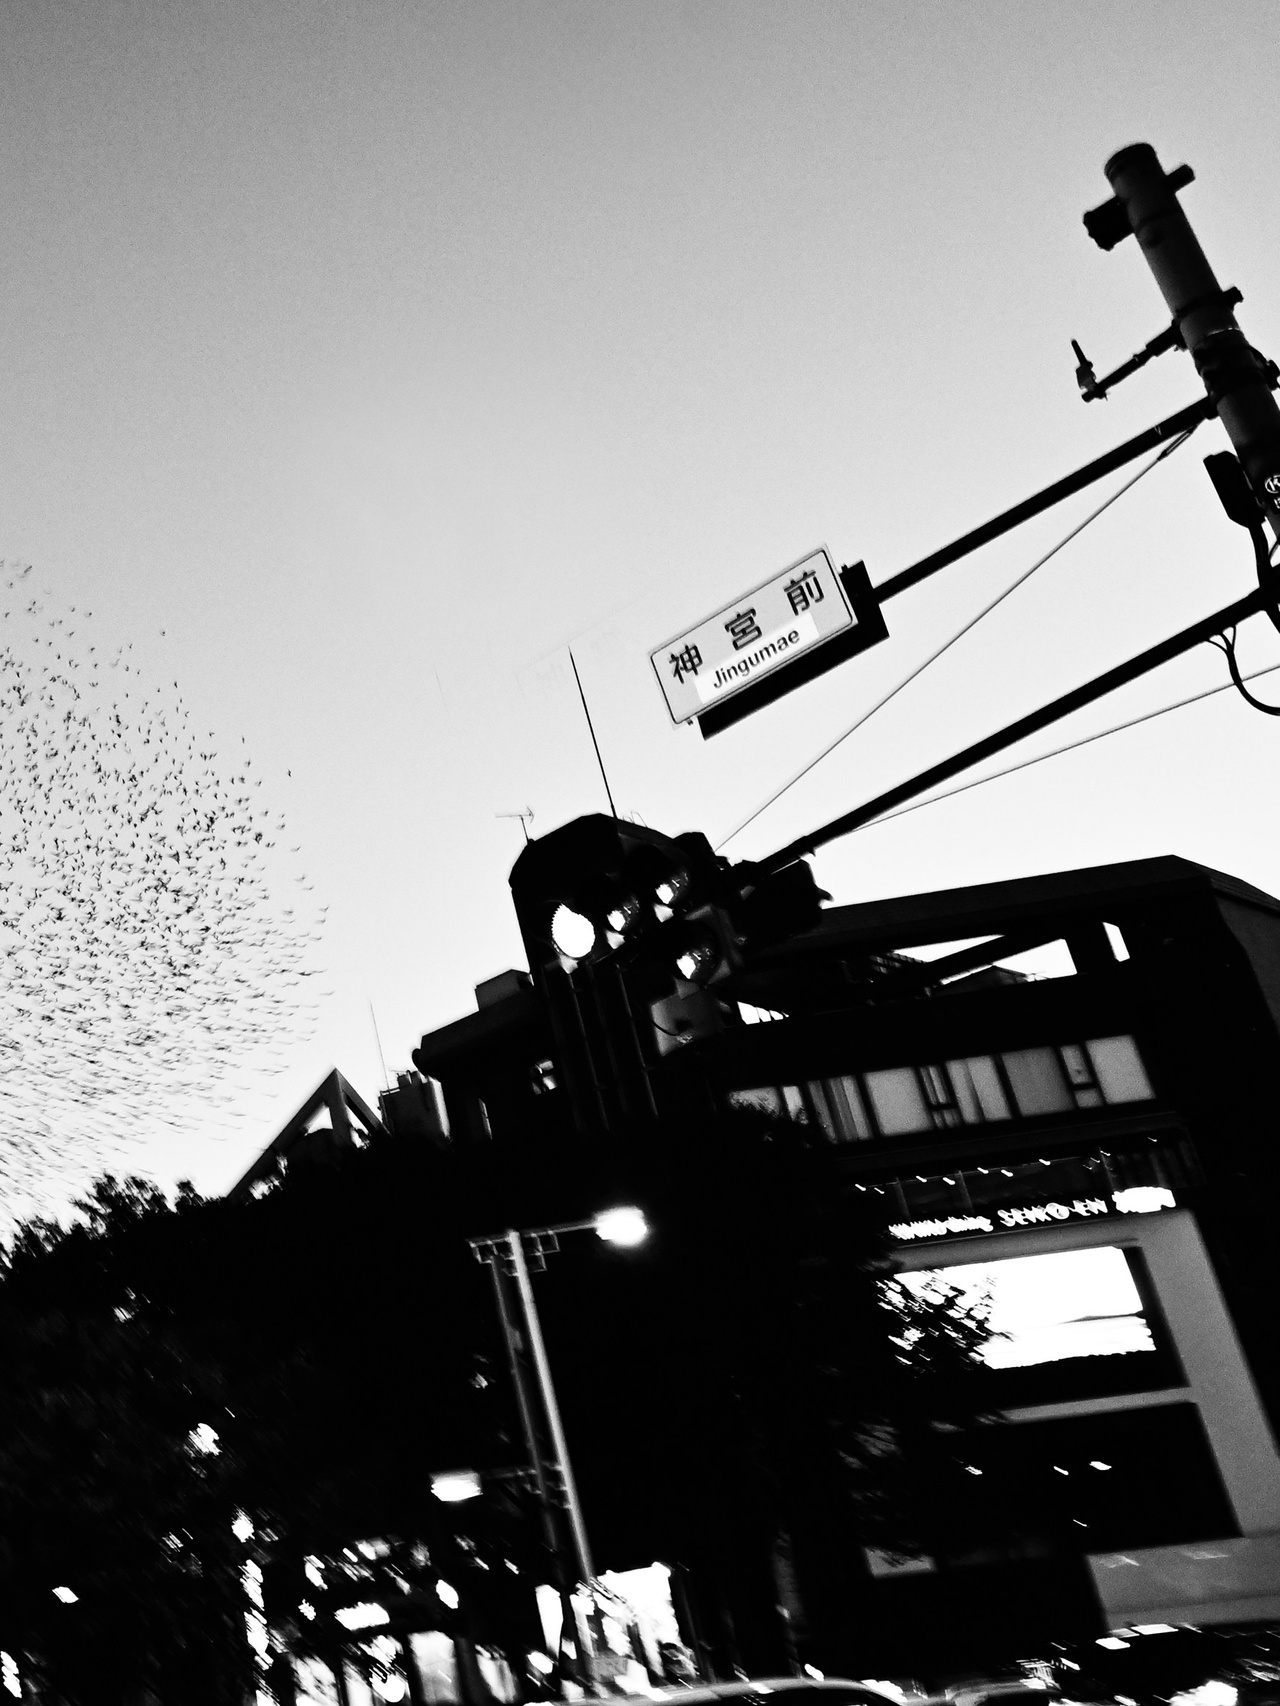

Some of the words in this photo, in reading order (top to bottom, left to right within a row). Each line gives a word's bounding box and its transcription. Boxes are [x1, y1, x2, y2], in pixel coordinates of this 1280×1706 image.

[668, 569, 825, 684] 神宮前
[713, 630, 801, 688] Jingumae
